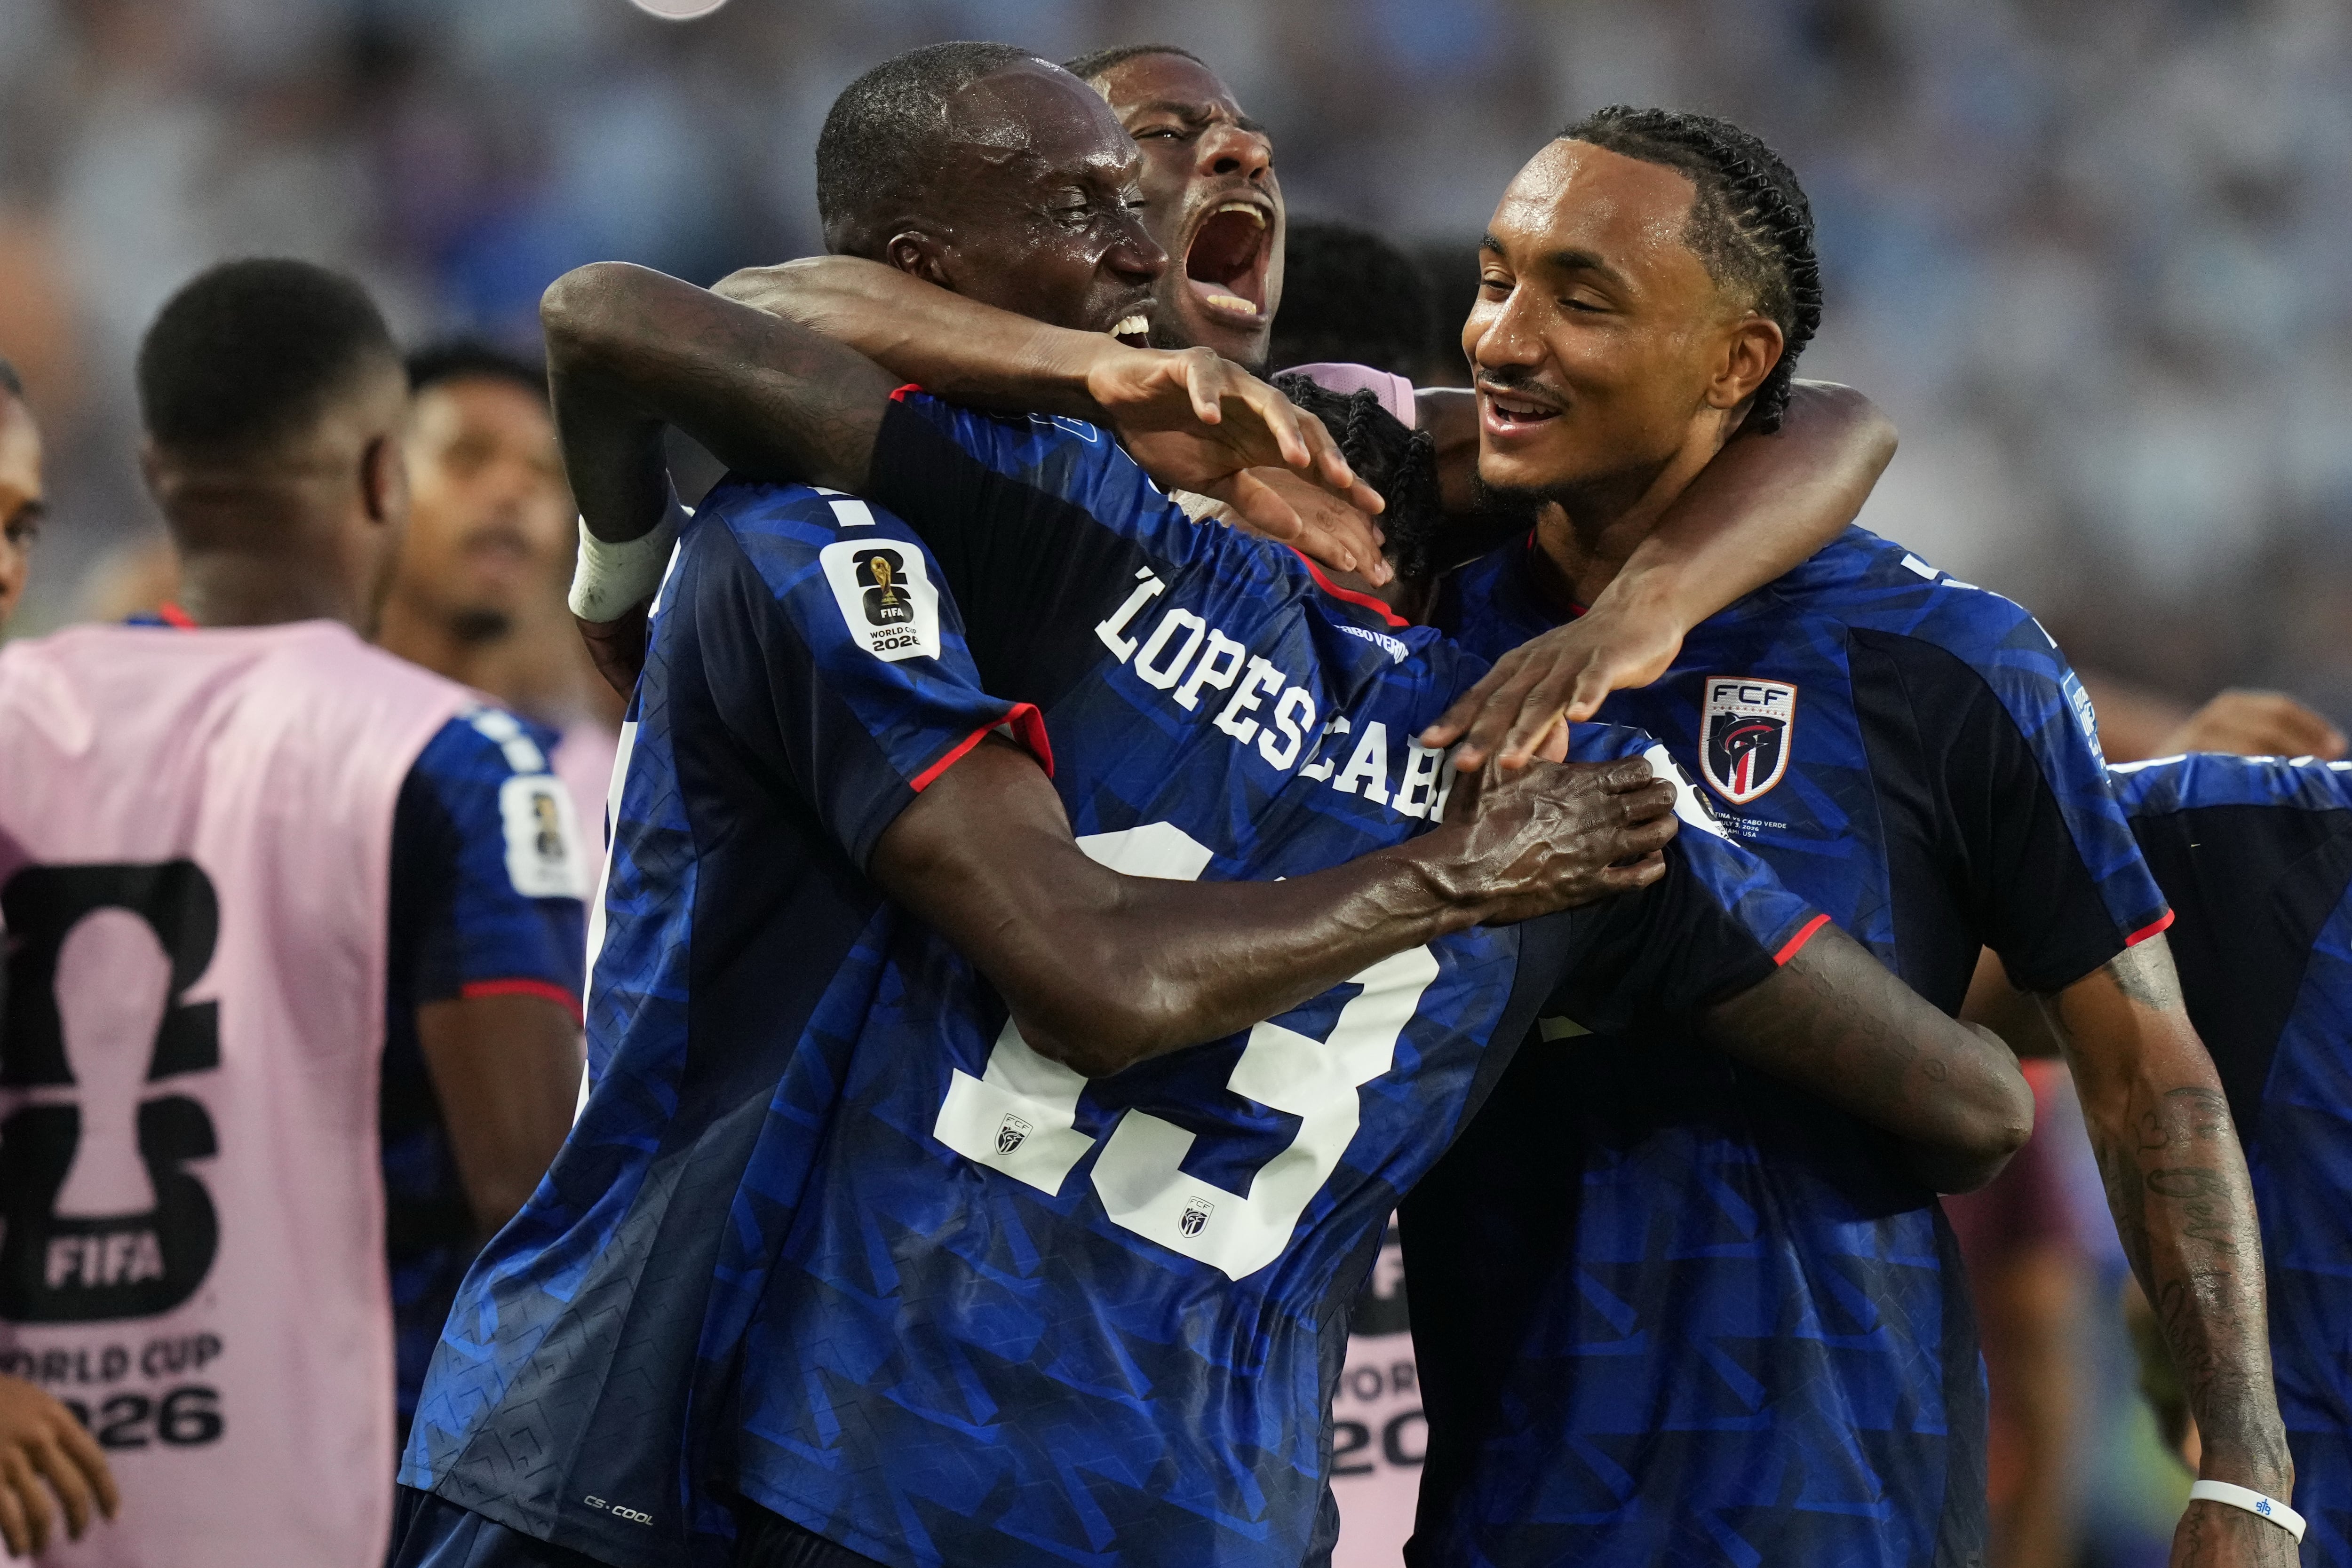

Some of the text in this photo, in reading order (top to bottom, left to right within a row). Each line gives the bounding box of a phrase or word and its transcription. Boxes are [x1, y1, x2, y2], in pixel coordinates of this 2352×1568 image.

[880, 608, 904, 618] FIFA
[870, 627, 903, 639] WORLD
[872, 635, 921, 651] 2026
[1094, 565, 1316, 771] LOPES
[1713, 685, 1788, 705] FCF
[1006, 1117, 1029, 1129] FCF
[1190, 1199, 1210, 1209] FCF
[45, 1230, 166, 1289] FIFA
[0, 1333, 222, 1382] ORLD CUP
[1330, 1410, 1426, 1476] 20
